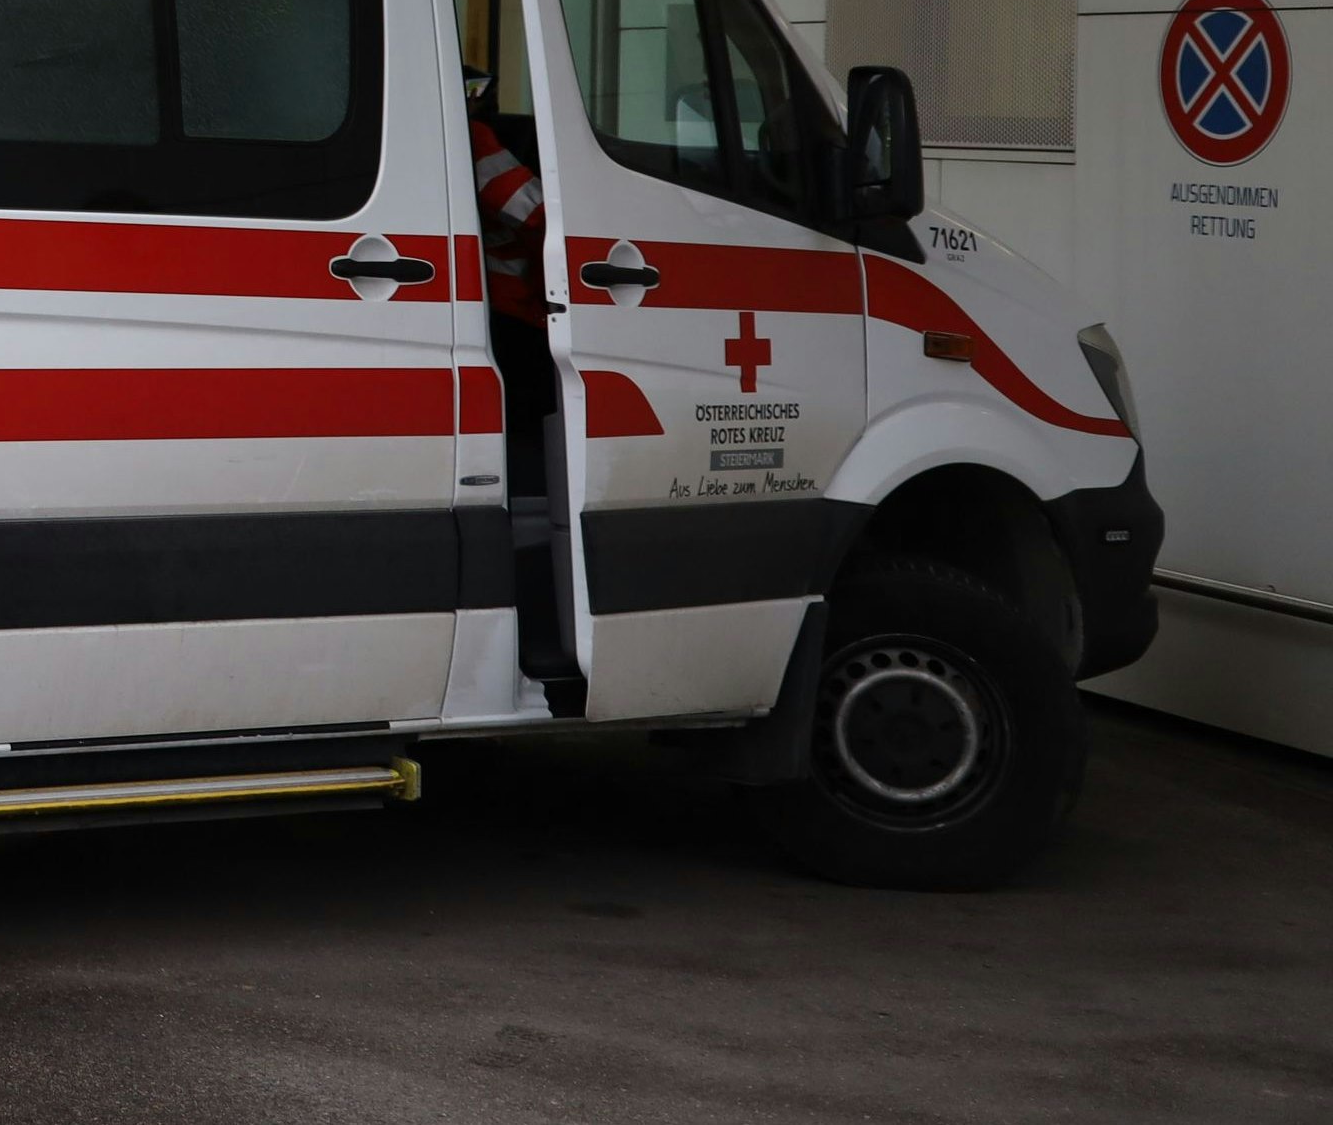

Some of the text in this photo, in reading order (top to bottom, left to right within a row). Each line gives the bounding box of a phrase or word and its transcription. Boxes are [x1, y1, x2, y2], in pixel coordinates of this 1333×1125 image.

[1170, 182, 1278, 209] AUSGENOMMEN
[929, 226, 978, 252] 71621
[1190, 215, 1255, 240] RETTUNG
[695, 402, 800, 422] ÖSTERREICHISCHES
[711, 426, 785, 445] ROTES KREUZ
[669, 477, 691, 499] Aus
[697, 475, 728, 497] Liebe
[733, 482, 757, 497] zum
